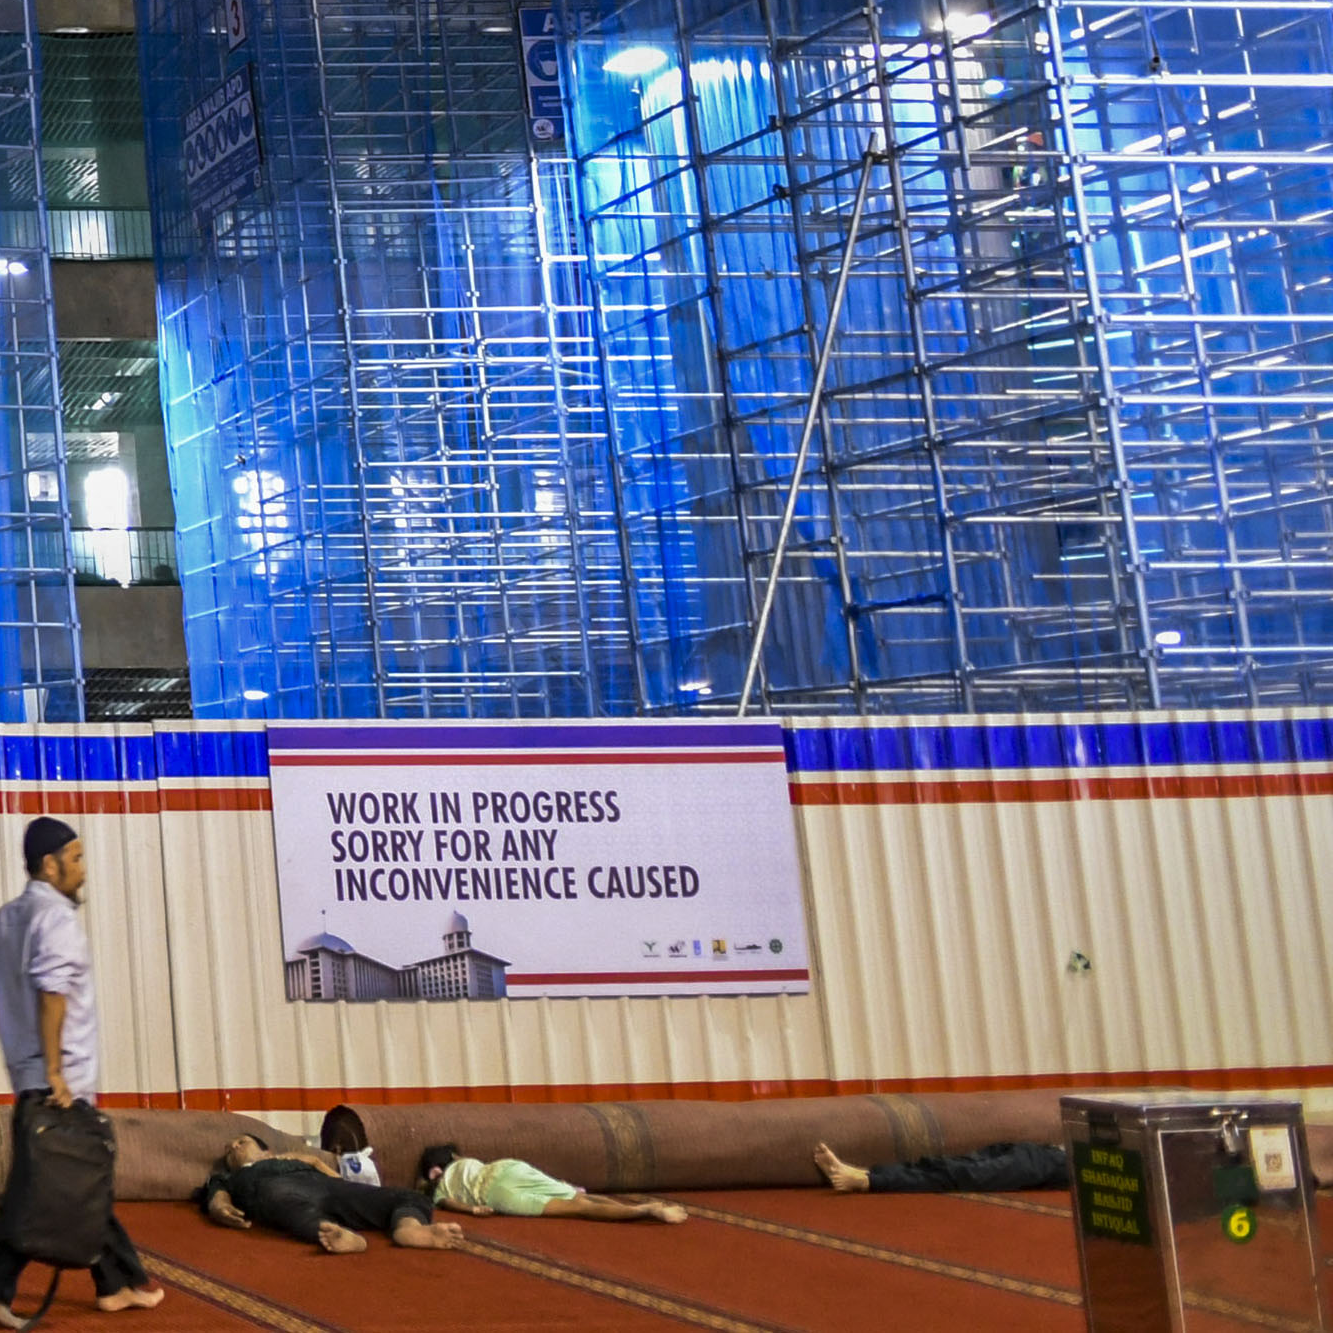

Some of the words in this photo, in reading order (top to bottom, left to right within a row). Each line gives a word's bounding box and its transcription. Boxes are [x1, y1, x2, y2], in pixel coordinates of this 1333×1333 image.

[230, 0, 240, 36] 3
[327, 791, 420, 825] WORK
[430, 791, 462, 824] IN
[473, 790, 621, 824] PROGRESS
[332, 830, 423, 863] SORRY
[435, 829, 491, 862] FOR
[502, 829, 558, 862] ANY
[334, 866, 577, 902] INCONVENIENCE
[587, 864, 700, 899] CAUSED
[1229, 1209, 1251, 1237] 6
